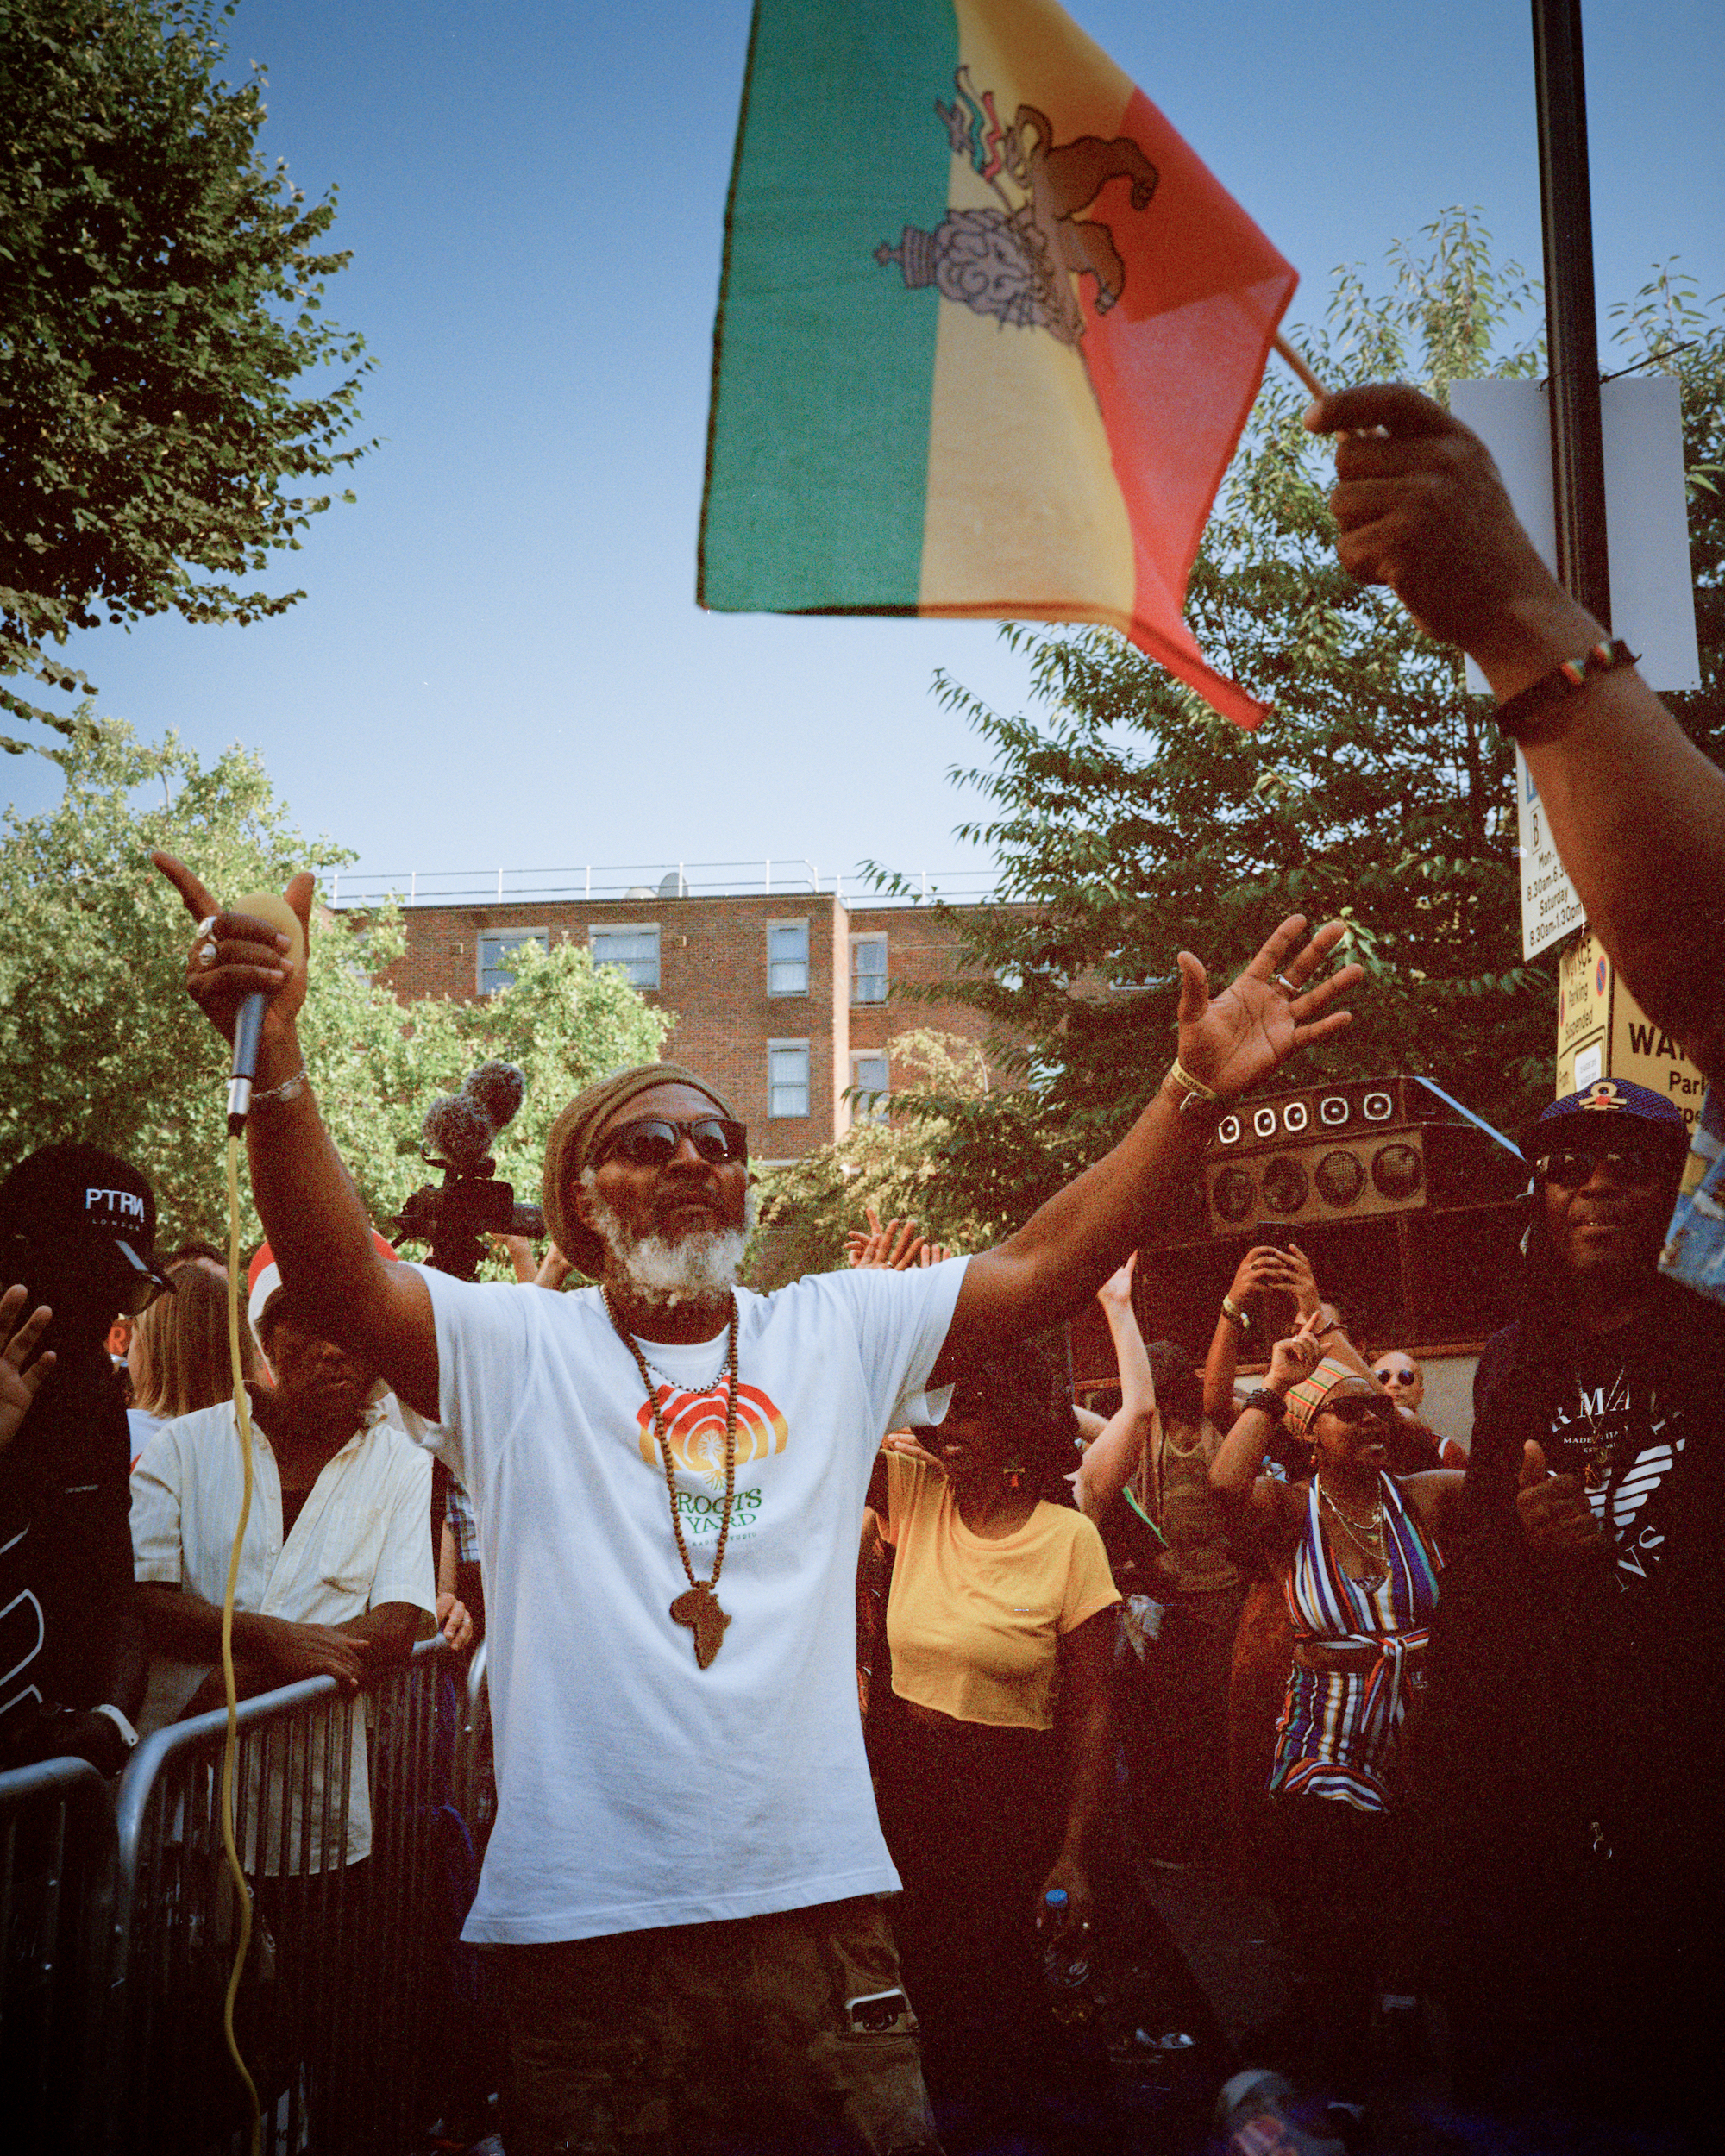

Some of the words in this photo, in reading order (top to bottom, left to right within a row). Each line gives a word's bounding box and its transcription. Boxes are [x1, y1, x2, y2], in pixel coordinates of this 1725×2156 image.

[1539, 851, 1552, 870] Mon
[1527, 863, 1565, 902] 8.30am-6.3
[1540, 887, 1568, 917] Saturday
[1569, 982, 1588, 1010] Parking
[1565, 1004, 1593, 1042] Suspended
[1563, 1436, 1592, 1445] MADE
[675, 1488, 762, 1514] ROOTS
[685, 1513, 756, 1533] YARD
